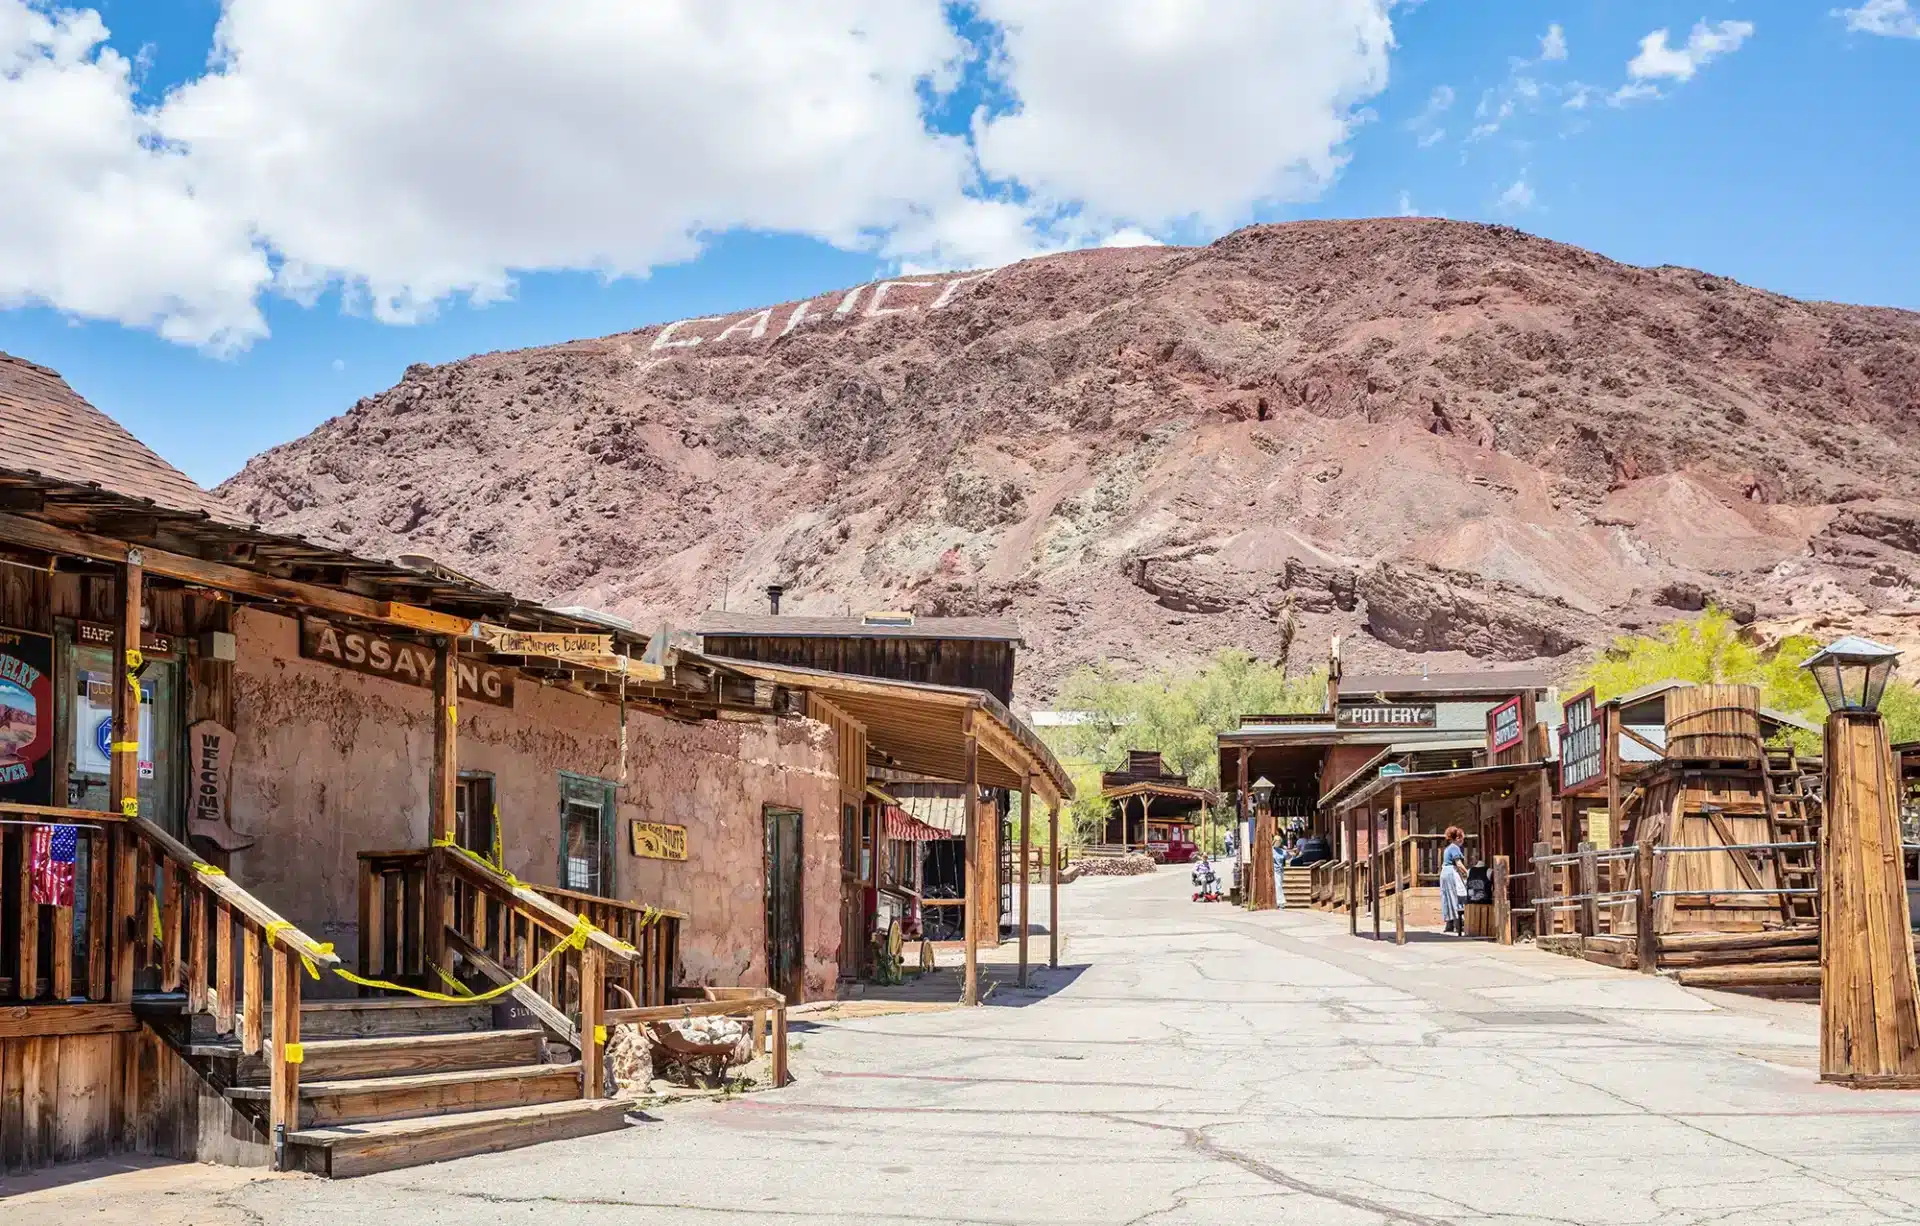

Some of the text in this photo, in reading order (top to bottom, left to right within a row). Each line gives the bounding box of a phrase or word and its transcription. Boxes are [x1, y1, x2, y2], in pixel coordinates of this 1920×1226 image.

[82, 626, 115, 642] HAPP
[318, 628, 501, 698] ASSAYNG
[1352, 707, 1421, 724] POTTERY
[197, 733, 221, 822] WELCOME
